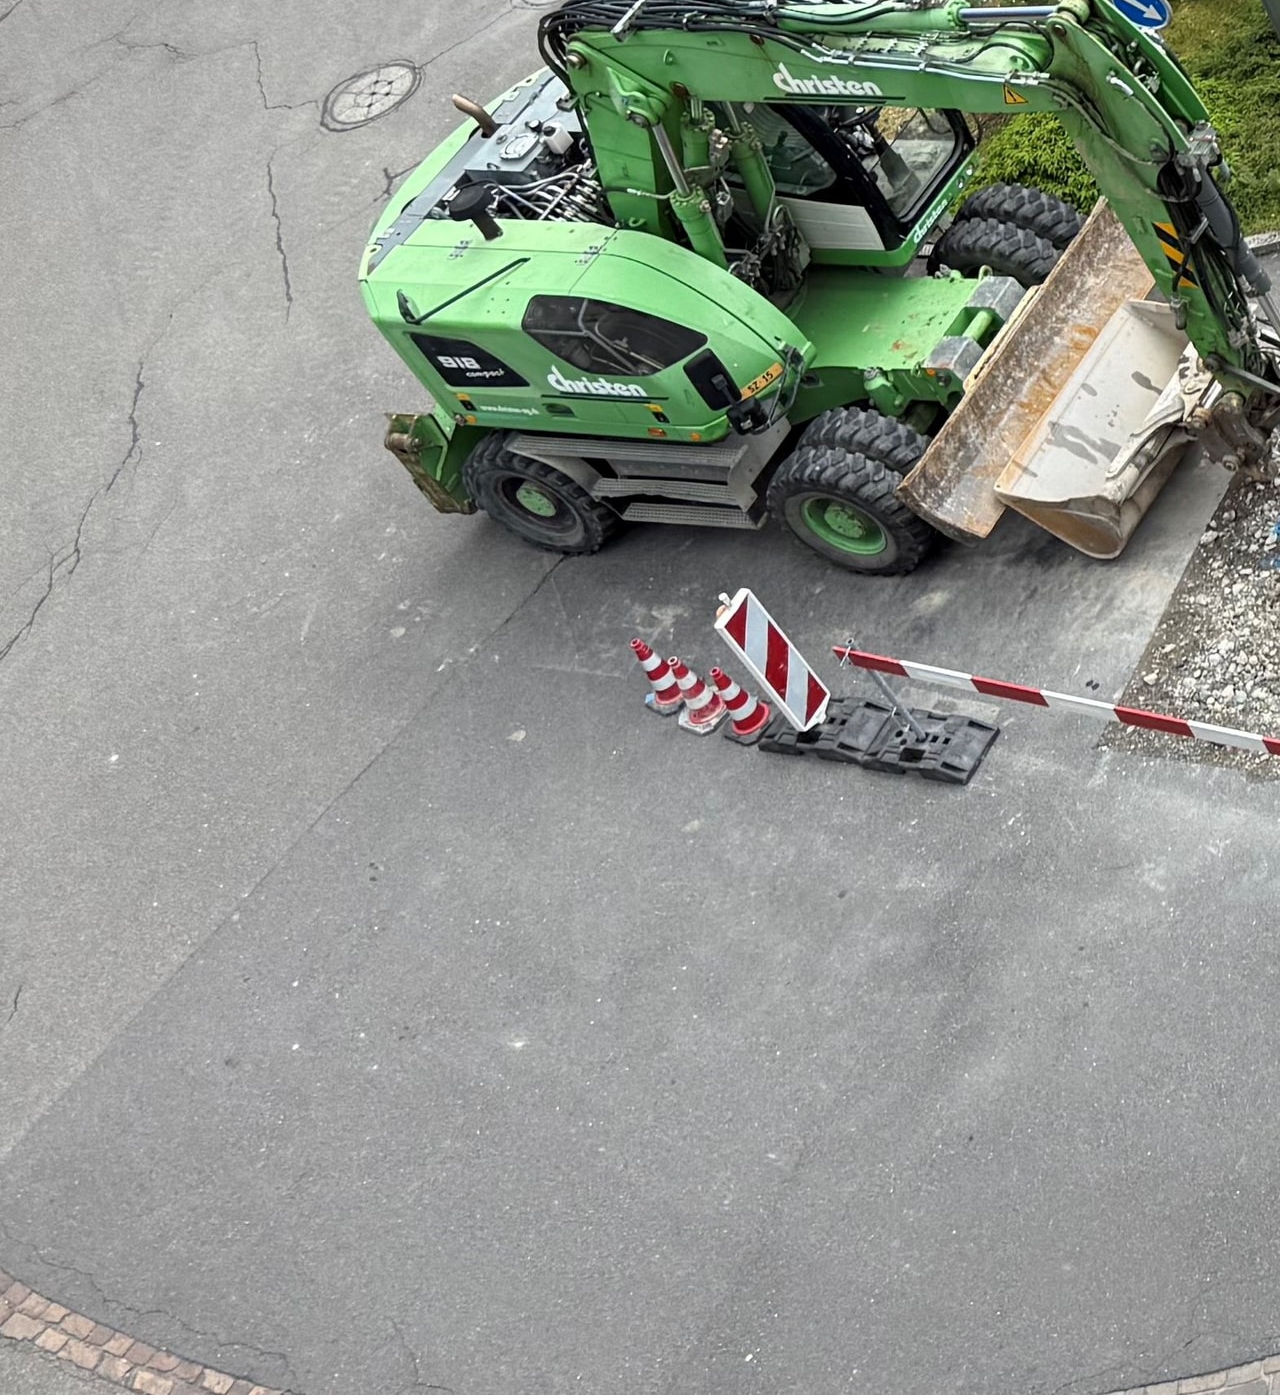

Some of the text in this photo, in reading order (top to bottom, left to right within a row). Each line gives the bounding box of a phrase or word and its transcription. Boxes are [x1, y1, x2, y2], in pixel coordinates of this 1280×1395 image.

[773, 62, 883, 96] christen
[913, 199, 948, 244] christen
[437, 356, 481, 369] 918
[547, 365, 647, 396] christen
